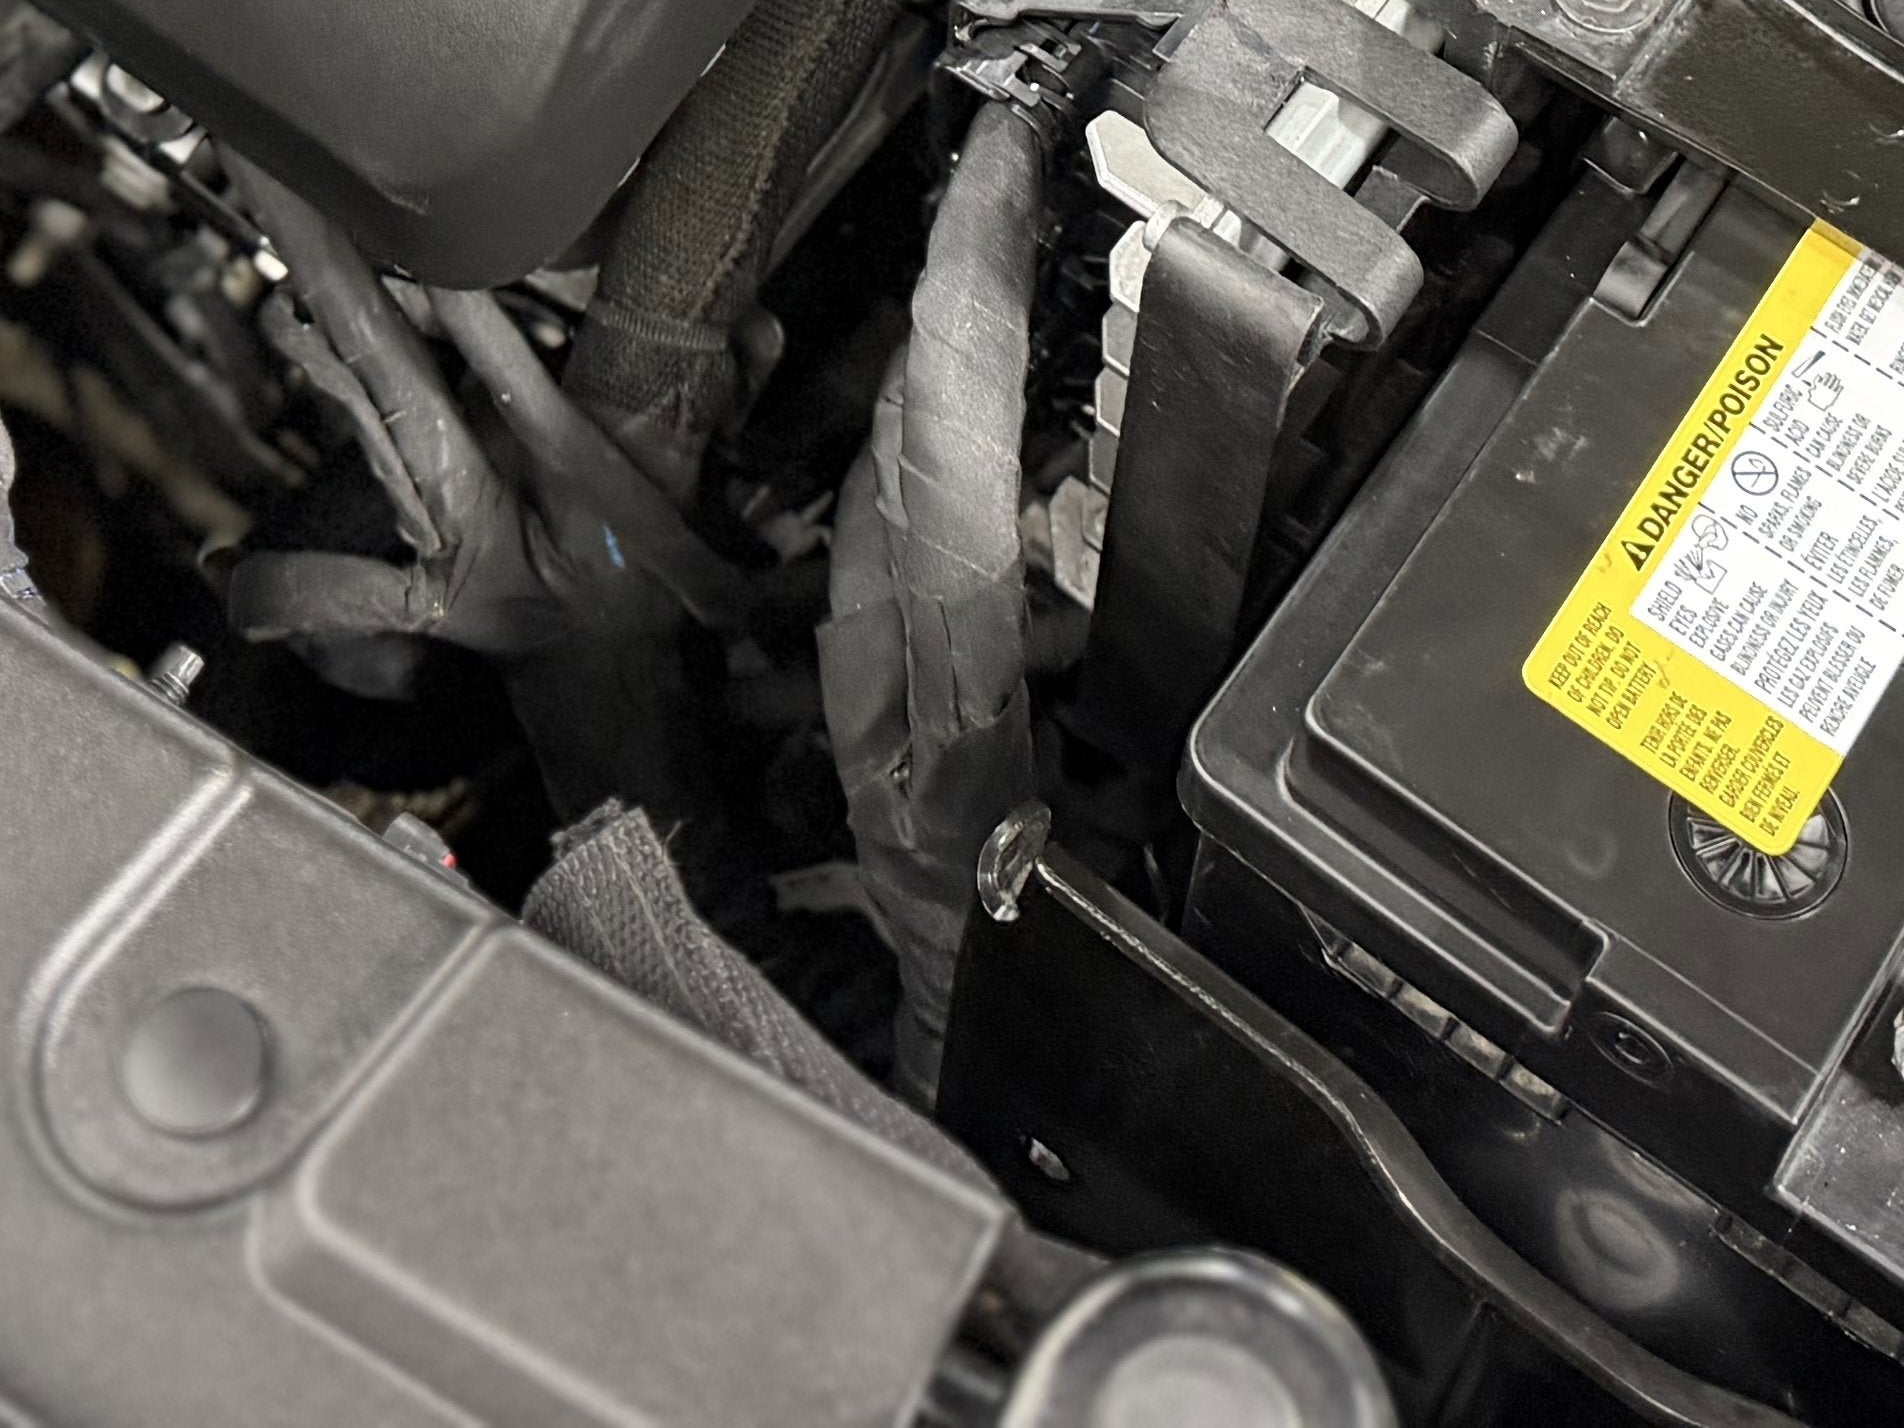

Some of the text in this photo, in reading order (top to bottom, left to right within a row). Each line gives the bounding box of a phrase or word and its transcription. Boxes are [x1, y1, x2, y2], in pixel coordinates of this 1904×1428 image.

[1763, 384, 1803, 432] SULFURIC
[1785, 419, 1809, 446] ACID
[1645, 335, 1783, 542] DANGER/POISON
[1806, 412, 1843, 458] CAN CAUSE
[1826, 414, 1870, 472] BLINDNESS OR
[1846, 425, 1892, 485] SEVERE BURNS
[1780, 466, 1812, 503] FLAMES
[1736, 505, 1758, 525] NO
[1779, 496, 1822, 552] OR SMOKING
[1801, 531, 1839, 571] ÉVITER
[1827, 563, 1848, 584] LES
[1647, 581, 1682, 621] SHIELD
[1848, 576, 1870, 597] LES
[1869, 593, 1888, 611] DE
[1548, 602, 1611, 689] KEEP OUT OF REACH
[1669, 605, 1697, 636] EYES
[1689, 597, 1729, 648] EXPLOSIVE
[1710, 581, 1767, 661] GASES CAN CAUSE
[1730, 578, 1798, 676] BLINDNESS OR INJURY
[1754, 590, 1828, 694] PROTÉGEZ LES YEUX
[1567, 685, 1584, 703] OF
[1605, 626, 1624, 644] DO
[1587, 692, 1608, 716] NOT
[1610, 661, 1629, 679] DO
[1620, 641, 1641, 665] NOT
[1777, 622, 1839, 708] LES GAZ EXPLOSIFS
[1799, 626, 1865, 723] PEUVENT BLESSER OU
[1606, 702, 1631, 729] OPEN
[1656, 703, 1680, 729] HORS
[1669, 691, 1687, 708] DE
[1711, 711, 1732, 732] PAS
[1820, 656, 1876, 736] RENDRE AVEUGLE
[1660, 752, 1677, 768] LA
[1686, 704, 1707, 726] DES
[1704, 727, 1721, 742] NE
[1719, 716, 1784, 808] GARDER COUVERCLES
[1739, 799, 1762, 823] BIEN
[1772, 751, 1790, 769] ET
[1759, 818, 1779, 836] DE
